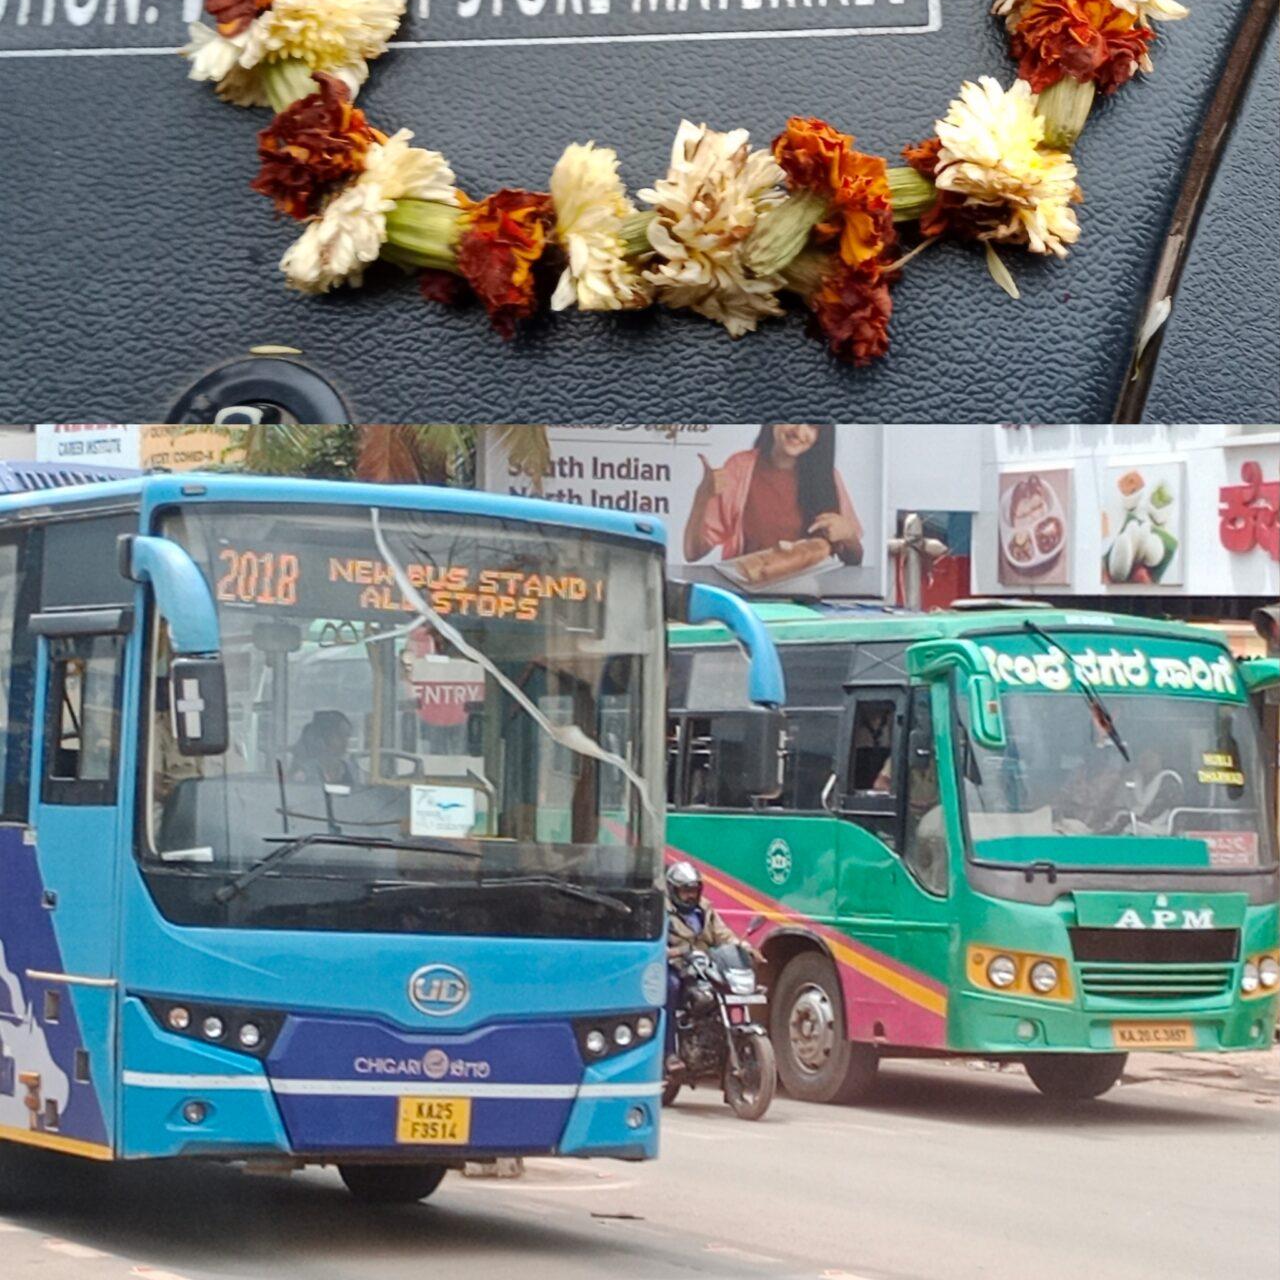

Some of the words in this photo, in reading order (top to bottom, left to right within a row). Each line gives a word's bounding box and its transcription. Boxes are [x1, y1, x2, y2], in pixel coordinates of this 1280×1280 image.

[592, 456, 671, 481] Indian
[591, 489, 670, 514] Indian
[329, 557, 397, 586] NEW
[408, 563, 470, 591] BUS
[478, 569, 588, 601] STAND
[432, 591, 540, 620] STOPS
[1072, 648, 1149, 687] ನಗರ
[1113, 909, 1215, 929] APM
[354, 1057, 421, 1075] CHIGARI
[416, 1102, 454, 1120] KA25
[410, 1122, 457, 1139] F3514
